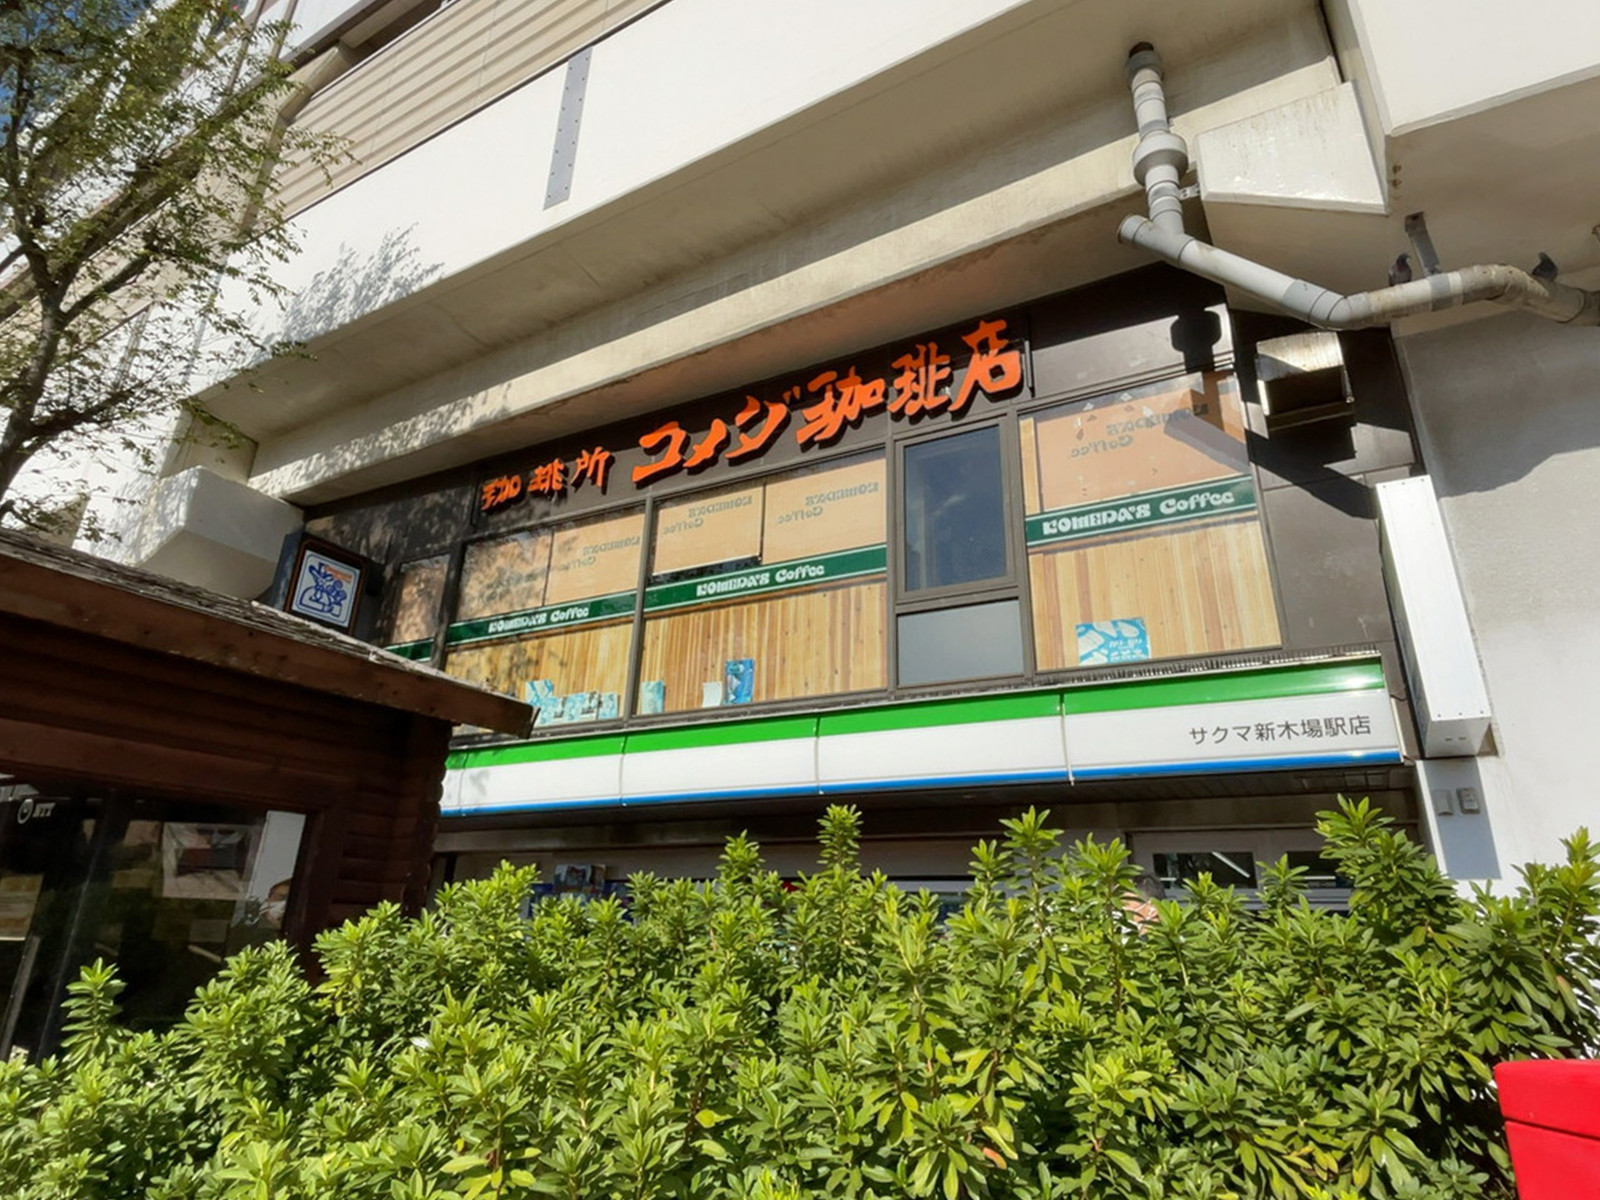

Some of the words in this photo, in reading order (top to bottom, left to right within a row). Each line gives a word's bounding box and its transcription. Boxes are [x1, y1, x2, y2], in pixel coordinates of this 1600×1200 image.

[481, 446, 611, 511] 珈琲所
[1042, 503, 1151, 536] KOMEDA'S
[1160, 490, 1235, 515] Coffee
[695, 572, 771, 597] KOMEDA'S
[775, 564, 826, 584] Coffee
[488, 612, 547, 634] KOMEDA'S
[550, 606, 590, 623] Coffee
[1188, 715, 1372, 745] サクマ新木場駅店
